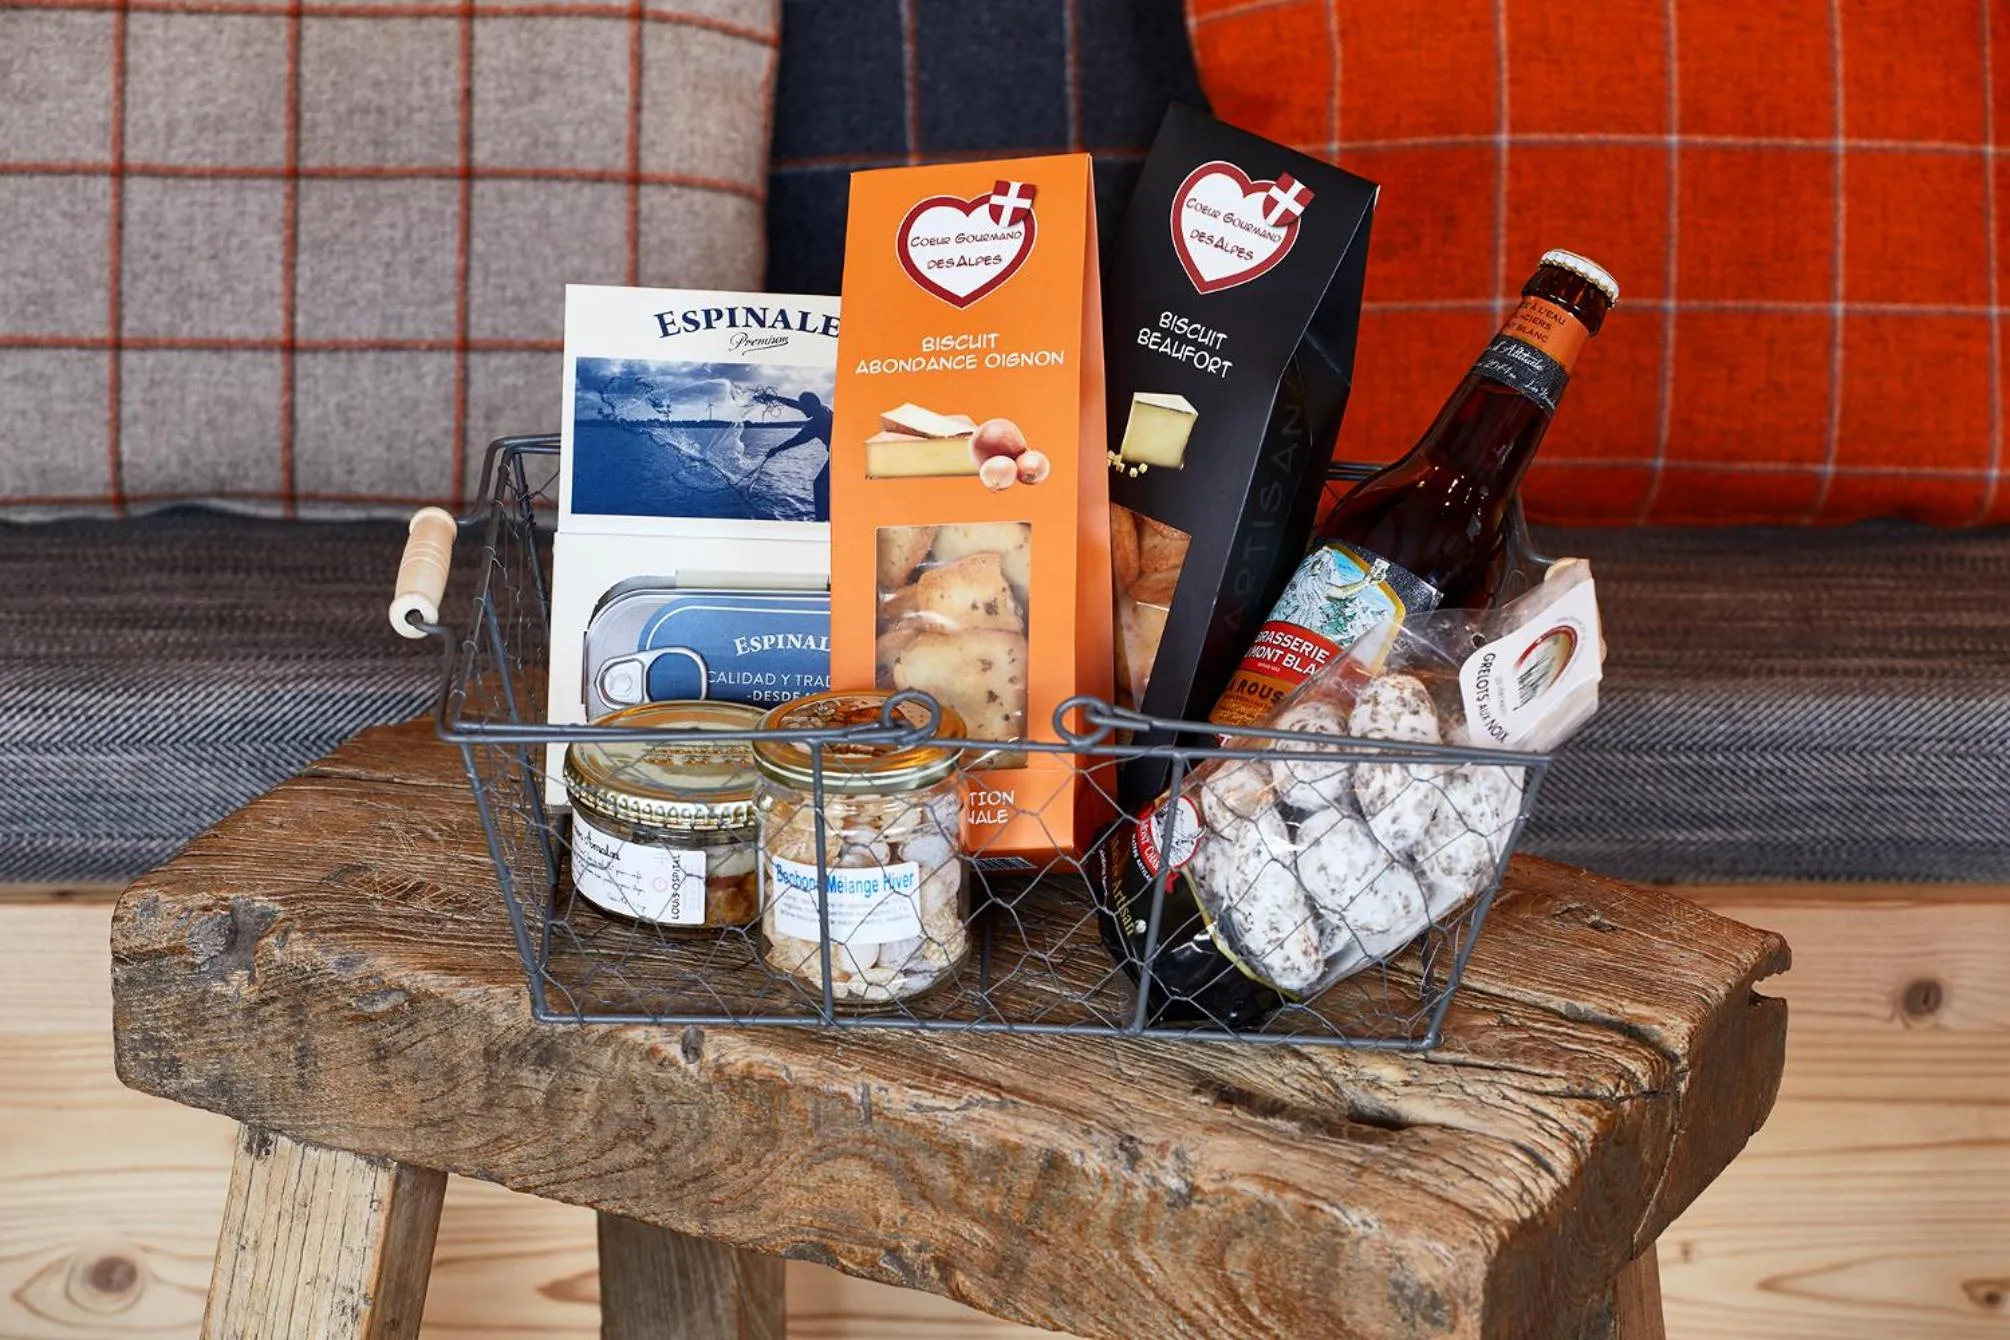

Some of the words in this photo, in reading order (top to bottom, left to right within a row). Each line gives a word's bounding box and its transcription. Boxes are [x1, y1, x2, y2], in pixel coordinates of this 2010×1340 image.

[653, 306, 840, 339] ESPINALE
[1158, 311, 1229, 351] BISCUIT
[728, 331, 790, 356] Premium
[921, 333, 1000, 352] BISCUIT
[1136, 327, 1234, 378] BEAUFORT
[855, 353, 978, 375] ABONDANCE
[984, 349, 1065, 369] OIGNON
[733, 632, 831, 656] ESPINAL
[1254, 630, 1331, 664] BRASSERIE
[780, 674, 792, 686] Y
[1474, 652, 1497, 706] GRELOTS
[775, 863, 819, 893] Bonbon
[883, 871, 915, 892] Hiver
[1112, 879, 1136, 937] Artisan
